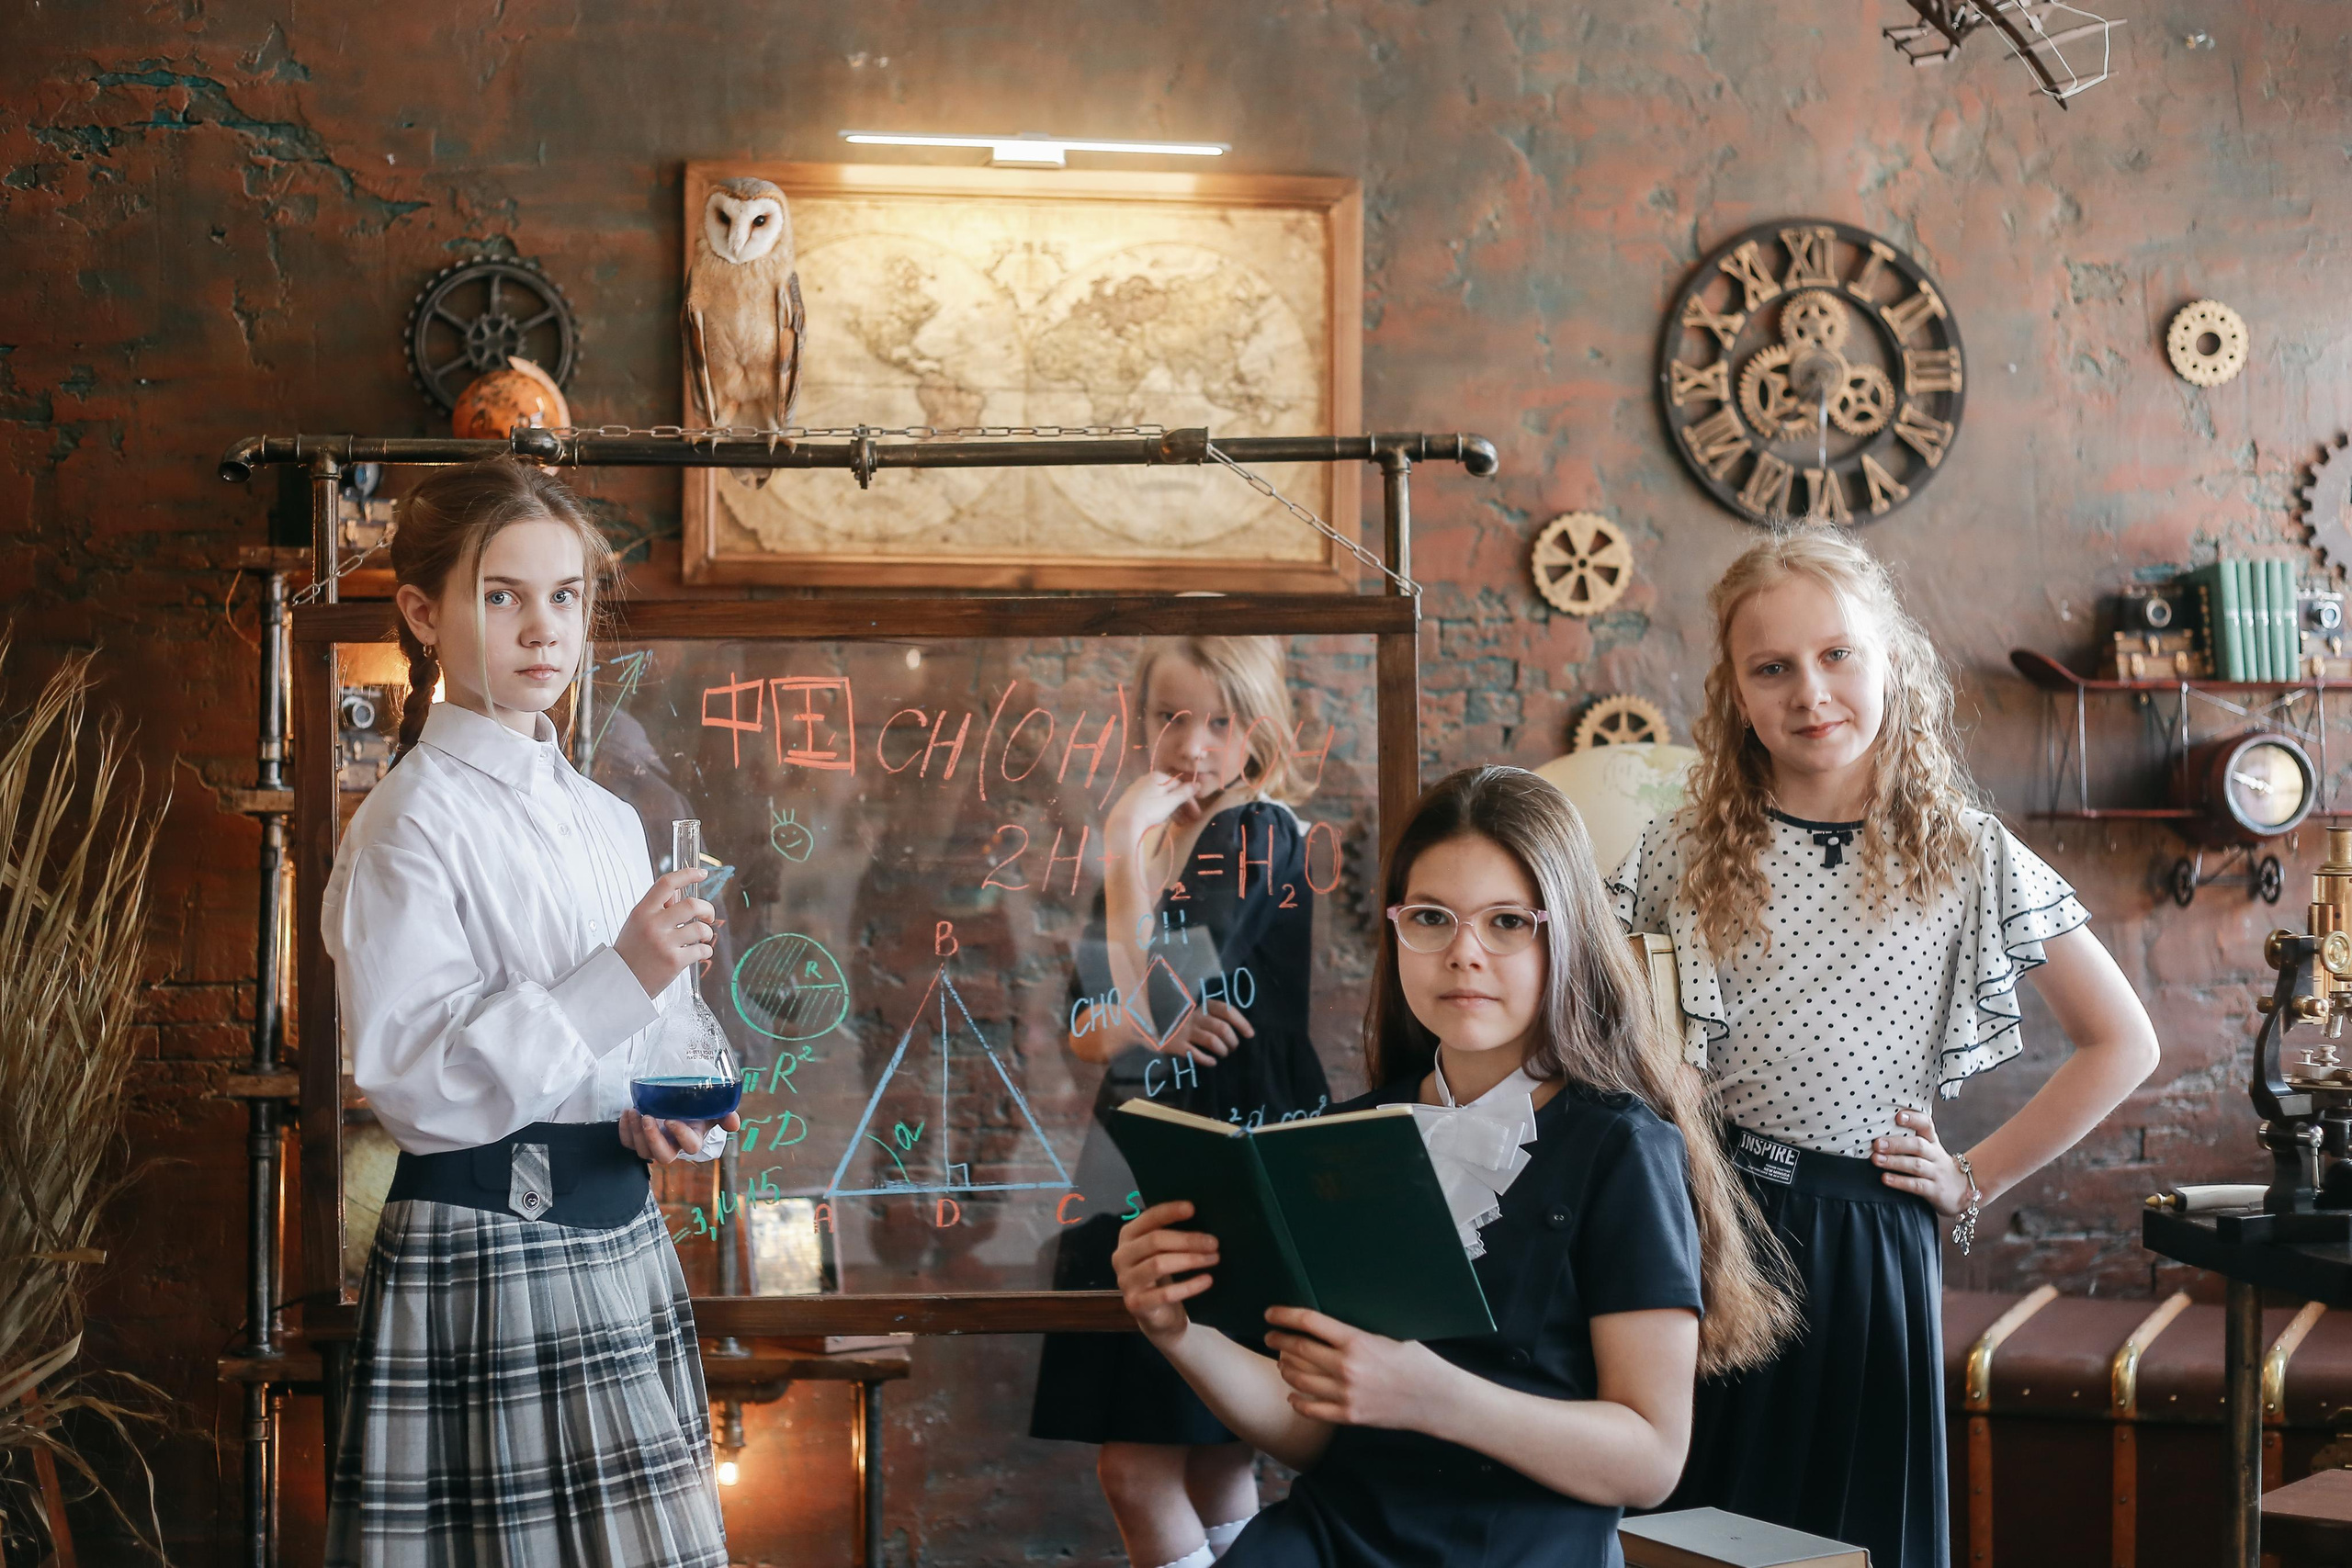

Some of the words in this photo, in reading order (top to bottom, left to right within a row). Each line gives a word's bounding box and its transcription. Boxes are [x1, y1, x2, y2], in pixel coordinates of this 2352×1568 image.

[1718, 240, 1782, 312] XI
[1780, 227, 1838, 289] XII
[1846, 240, 1896, 303] I
[1681, 292, 1746, 351] X
[1880, 279, 1947, 345] II
[1670, 358, 1730, 407] IX
[1903, 346, 1962, 397] III
[1681, 404, 1752, 481] VIII
[1894, 401, 1955, 468] IV
[1736, 451, 1795, 522] VII
[1803, 468, 1854, 525] VI
[1860, 454, 1910, 516] V
[934, 920, 958, 956] B
[805, 960, 822, 979] R
[1200, 967, 1256, 1017] HO
[1070, 987, 1122, 1039] CHO
[1144, 1051, 1198, 1098] CH
[1741, 1134, 1795, 1166] INSPIRE
[814, 1202, 835, 1235] A
[935, 1198, 961, 1228] D
[1056, 1193, 1085, 1224] C
